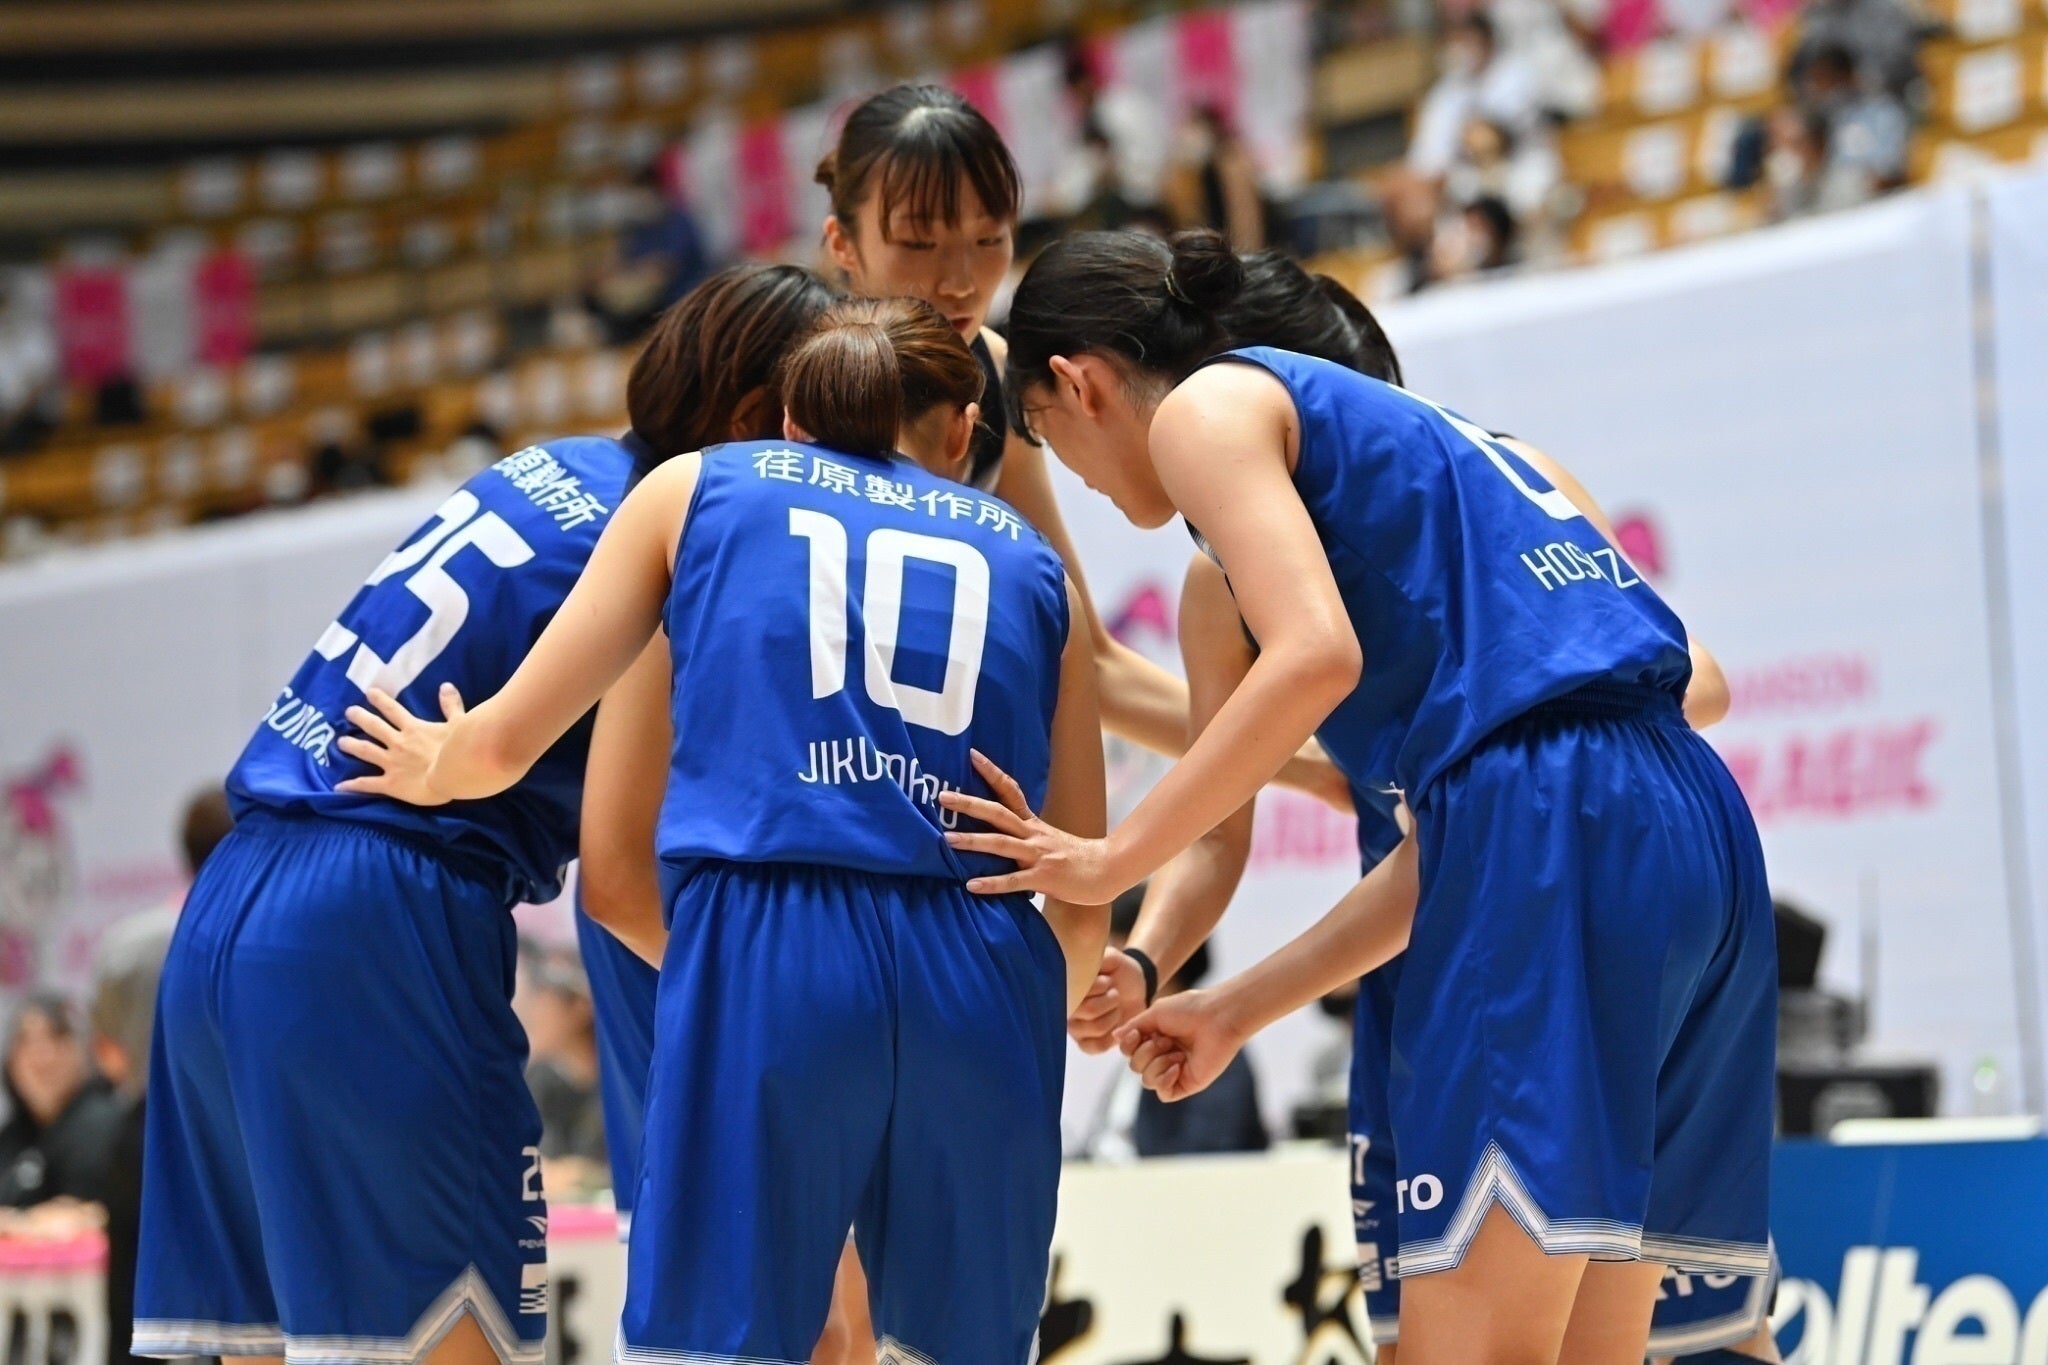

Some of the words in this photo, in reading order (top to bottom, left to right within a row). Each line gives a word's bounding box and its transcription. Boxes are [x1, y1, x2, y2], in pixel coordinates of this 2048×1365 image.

[491, 445, 608, 531] 原製作所
[752, 449, 1022, 541] 荏原製作所
[314, 489, 535, 701] 25
[789, 507, 990, 737] 10
